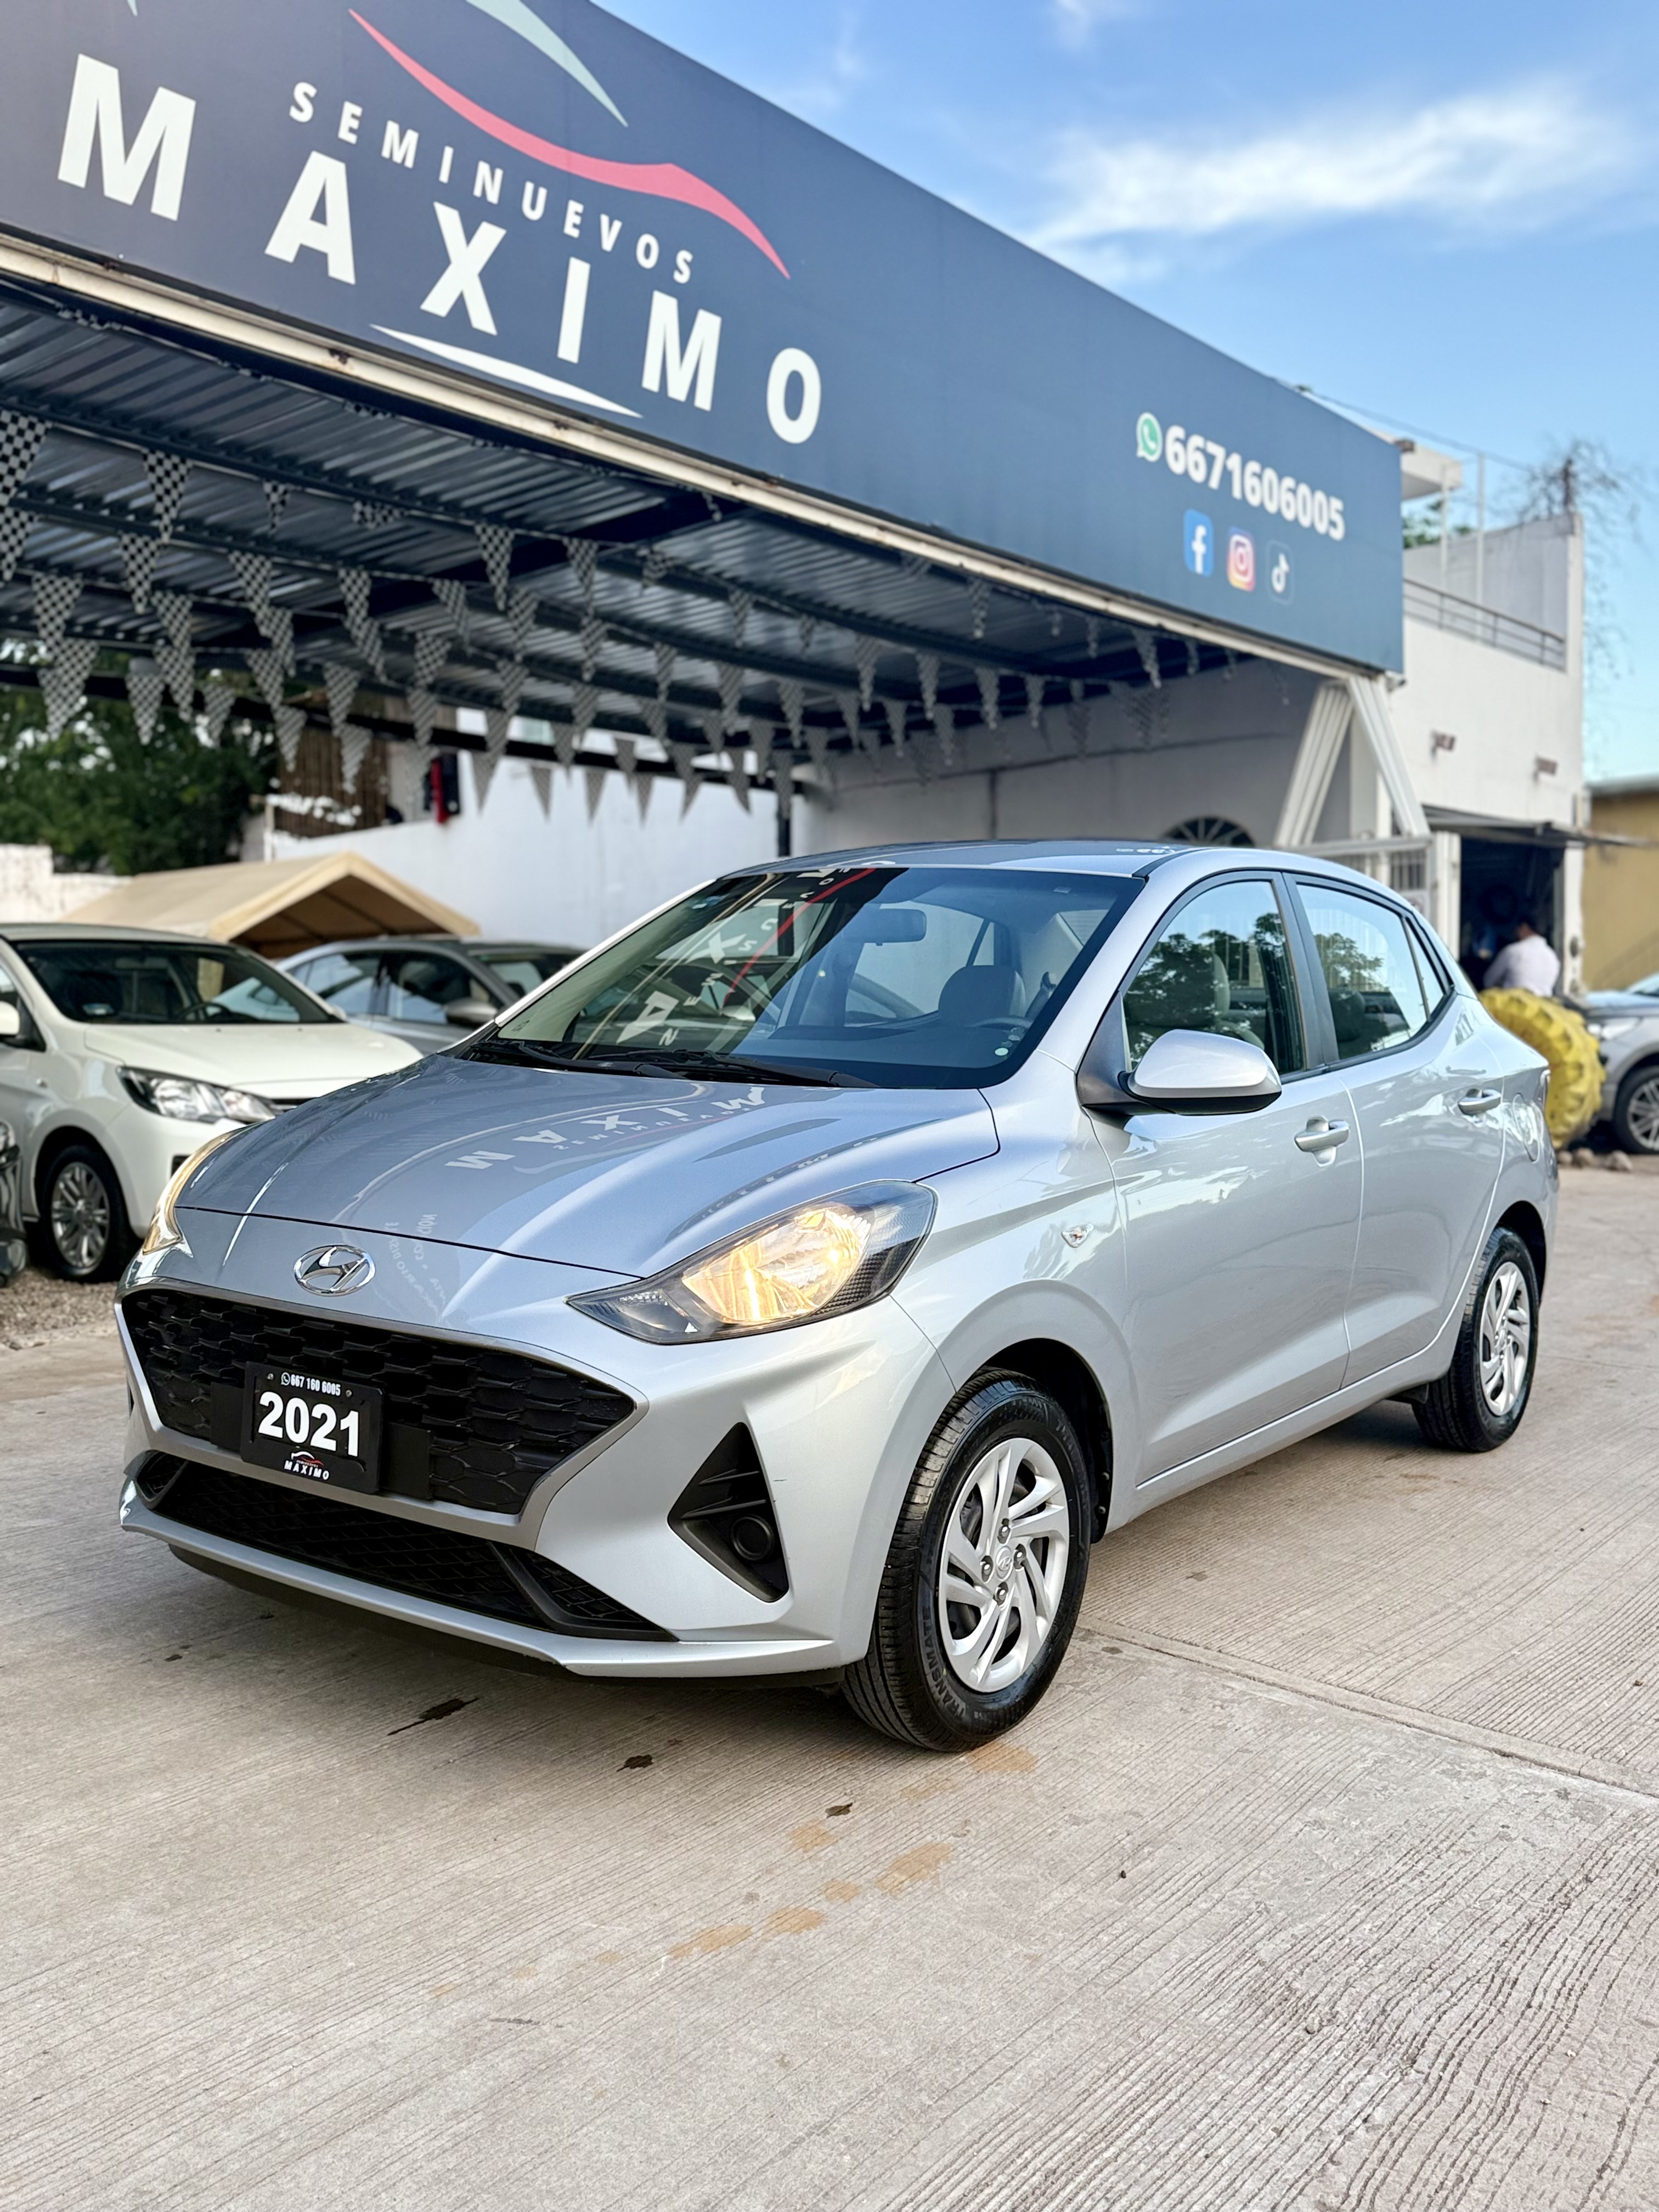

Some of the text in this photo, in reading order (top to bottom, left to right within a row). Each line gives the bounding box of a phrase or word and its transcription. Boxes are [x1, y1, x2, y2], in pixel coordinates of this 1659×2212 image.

[289, 82, 693, 283] SEMINUEVOS
[58, 53, 821, 444] MAXIMO
[1165, 425, 1346, 541] 6671606005
[258, 1391, 359, 1457] 2021
[290, 1374, 341, 1396] 667 160 6005
[284, 1460, 330, 1480] MAXIMO
